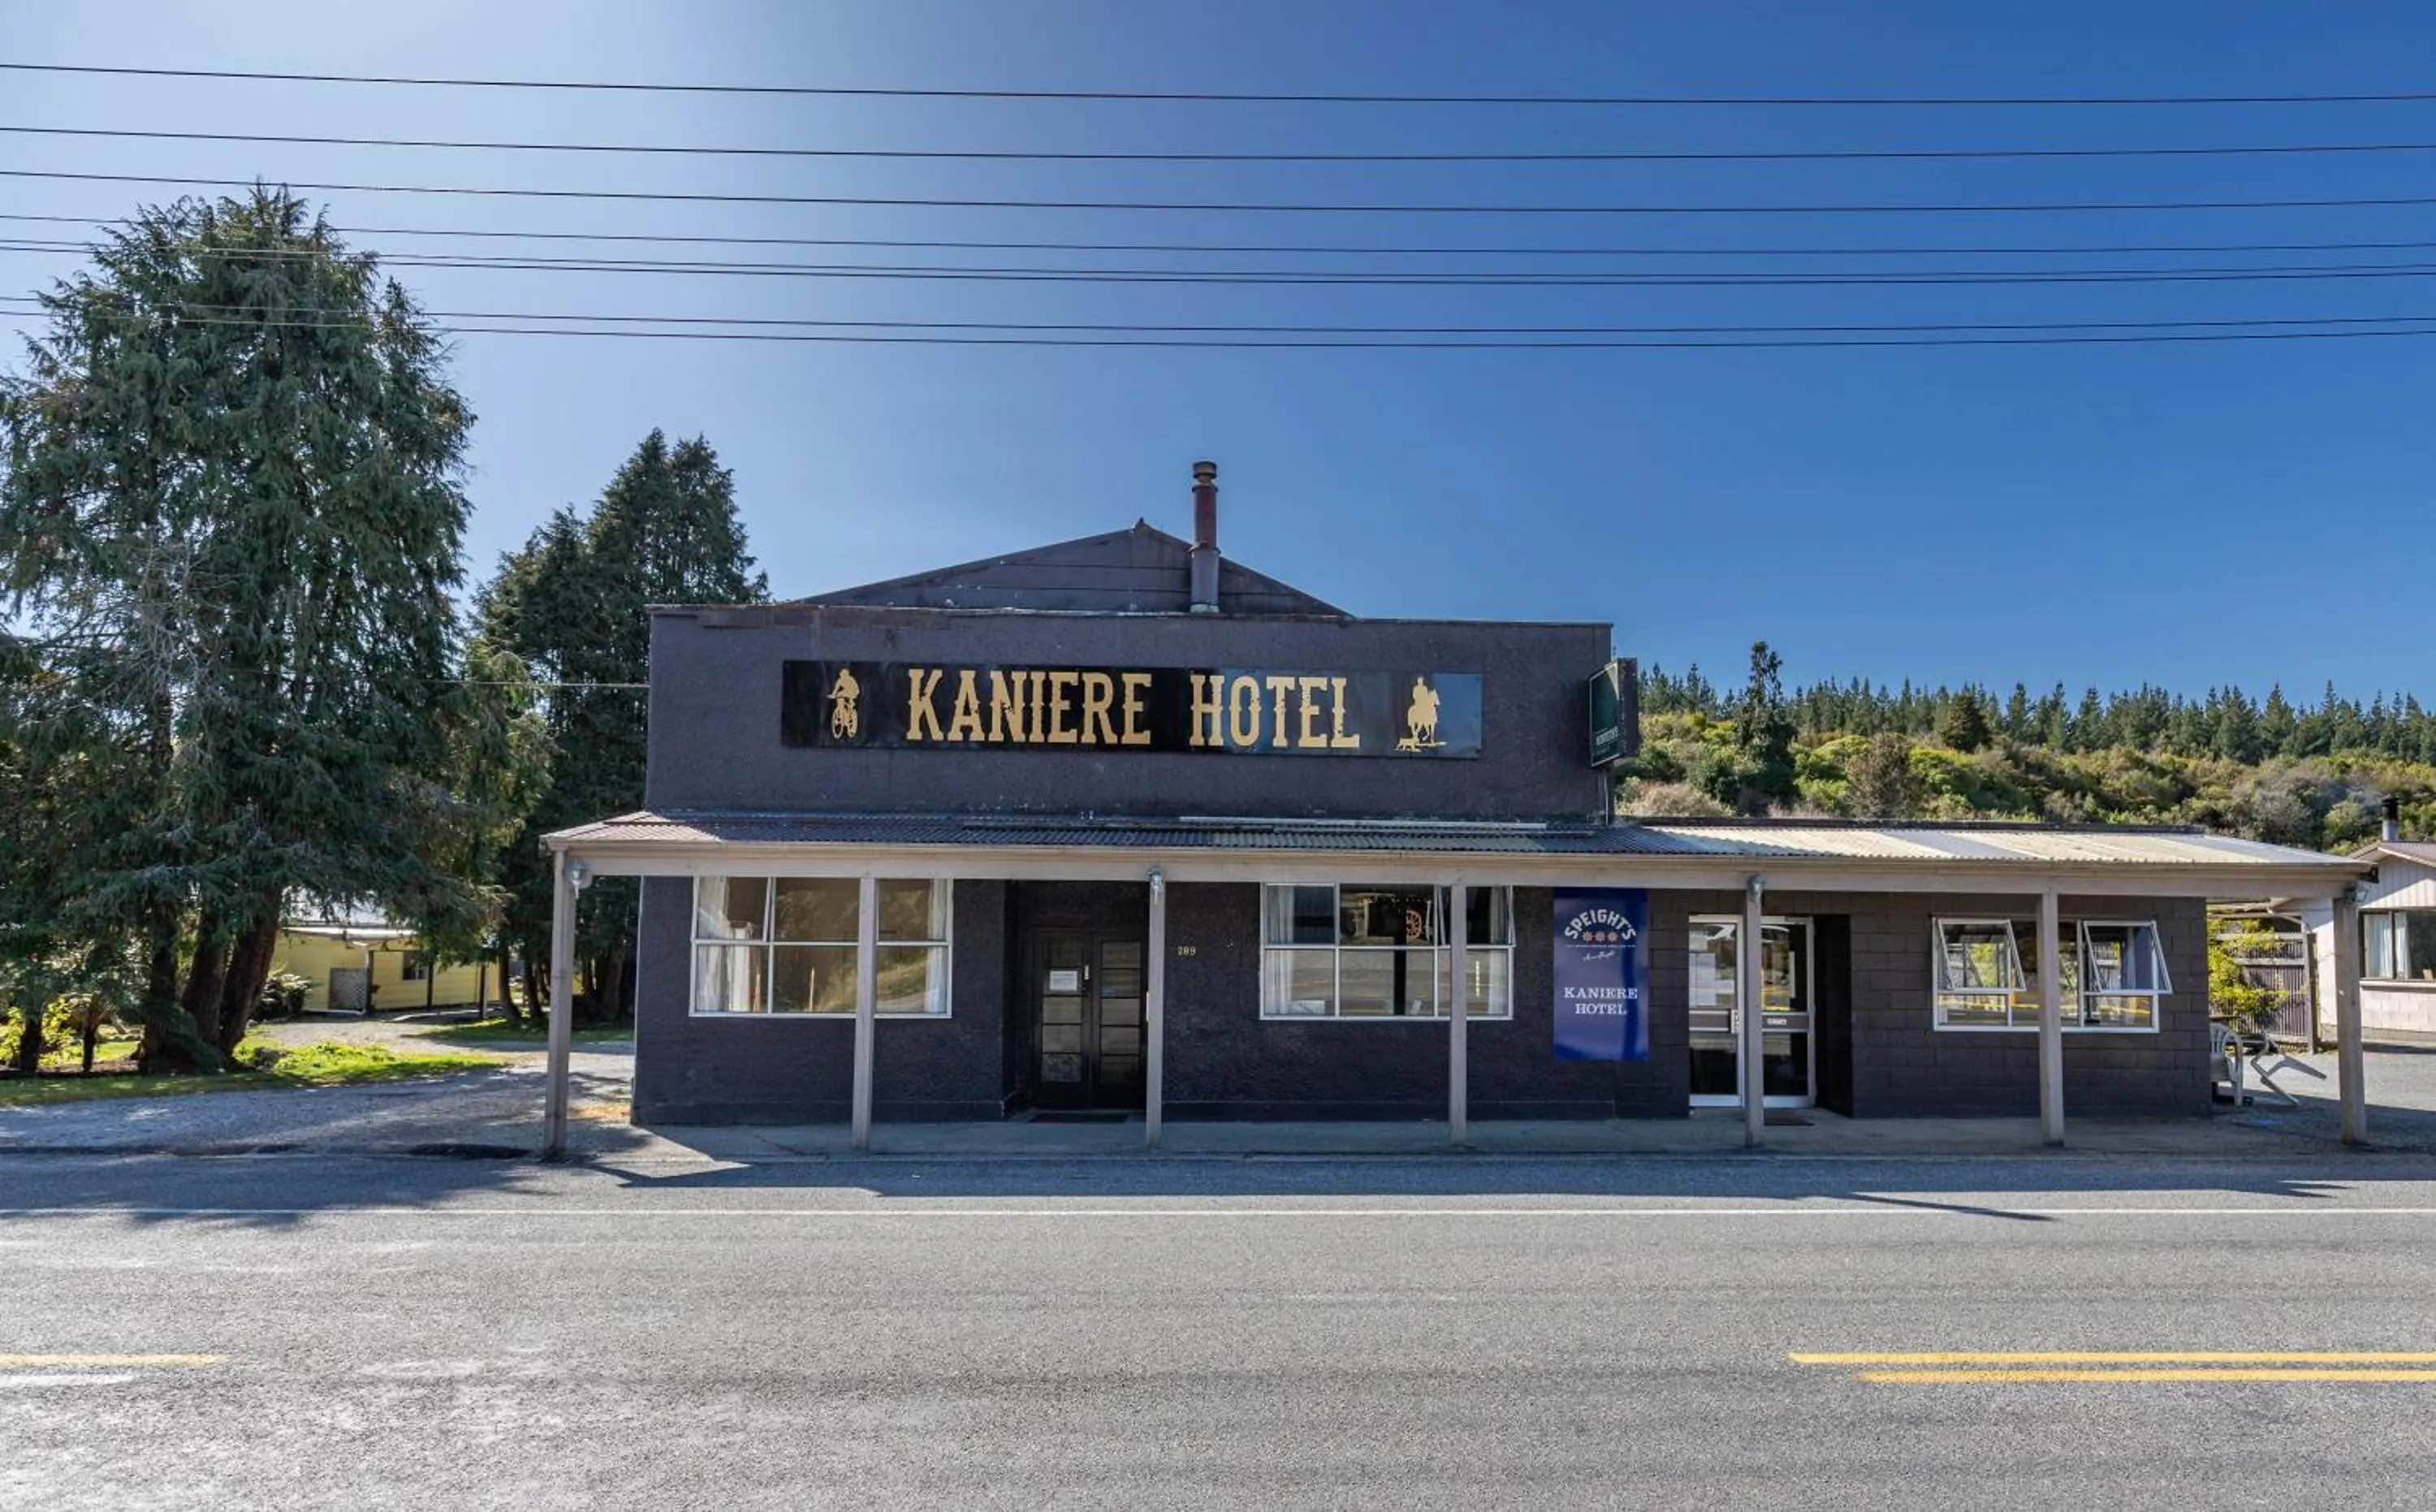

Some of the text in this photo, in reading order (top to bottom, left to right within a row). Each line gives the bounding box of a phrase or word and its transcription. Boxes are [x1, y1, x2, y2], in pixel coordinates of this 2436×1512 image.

[906, 668, 1360, 747] KANIERE HOTEL
[1565, 909, 1636, 940] SPEIGHT'S
[1564, 987, 1638, 999] KANIERE
[1575, 1004, 1626, 1014] HOTEL
